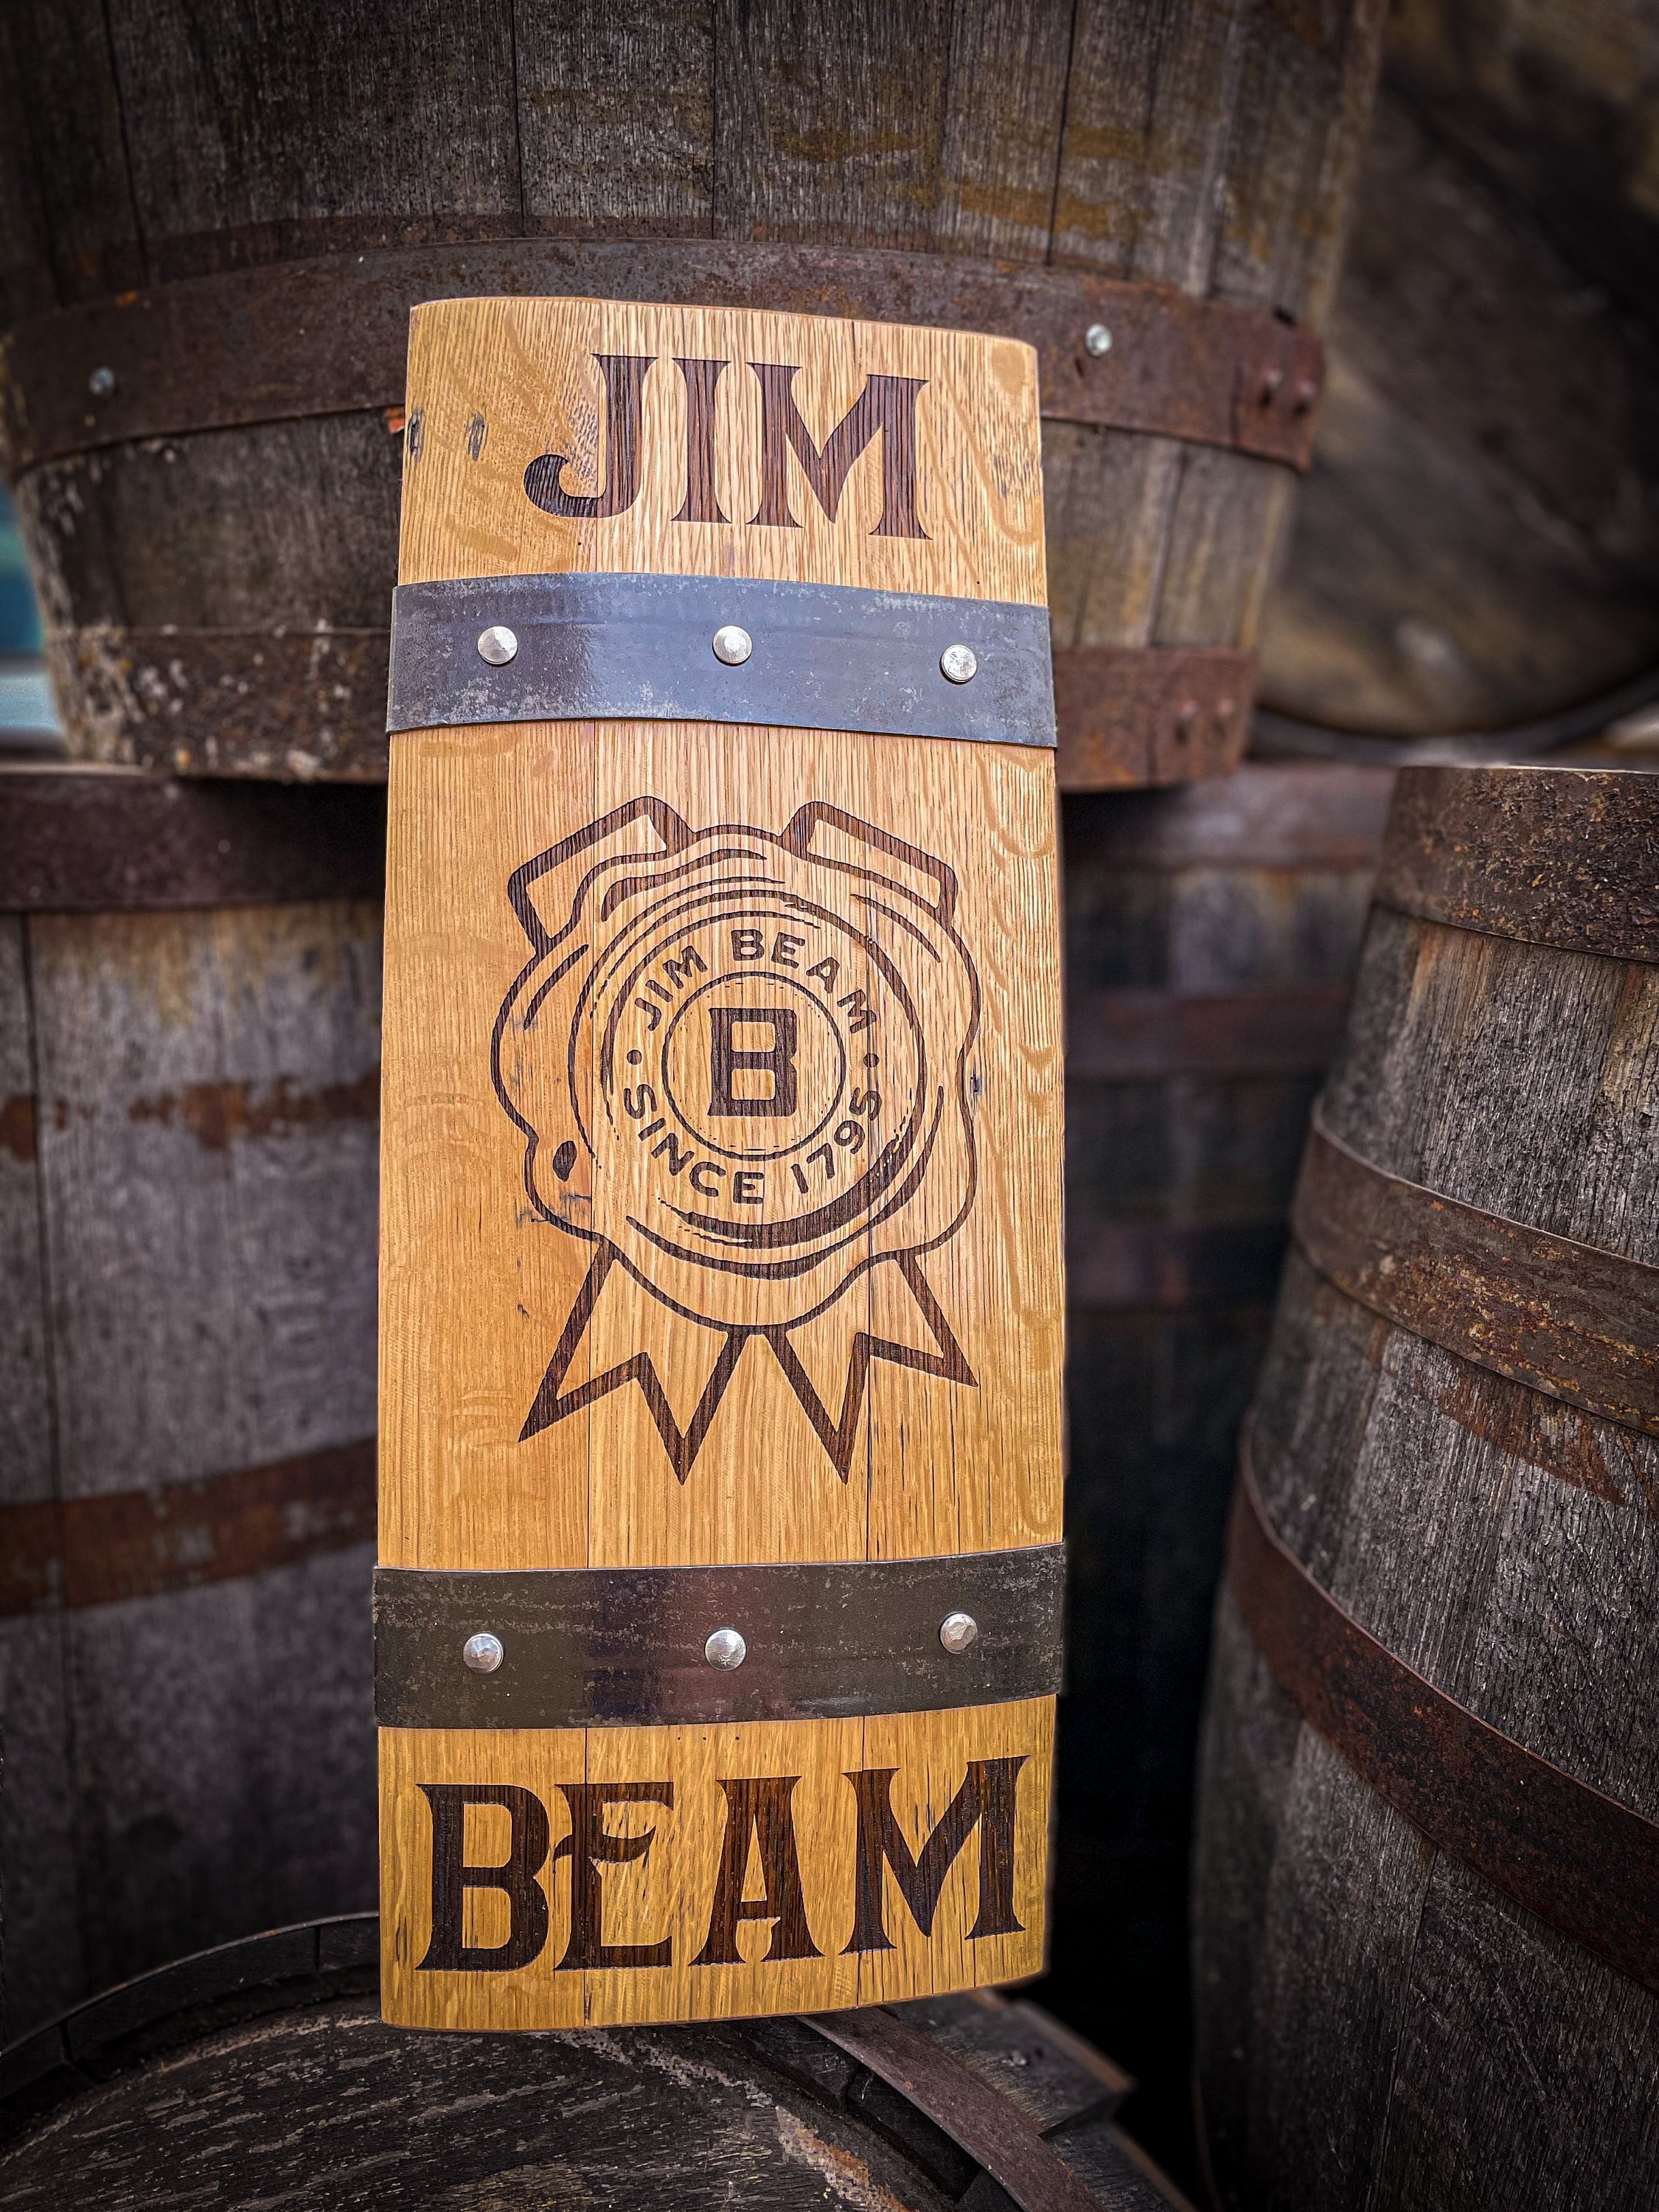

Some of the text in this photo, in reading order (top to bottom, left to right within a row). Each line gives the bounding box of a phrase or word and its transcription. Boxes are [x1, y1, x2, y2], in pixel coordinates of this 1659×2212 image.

[524, 353, 933, 540] JIM
[634, 929, 877, 1034] JIM BEAM
[707, 1008, 797, 1116] B
[624, 1084, 882, 1203] SINCE 1795
[416, 1756, 1031, 1972] BEAM
